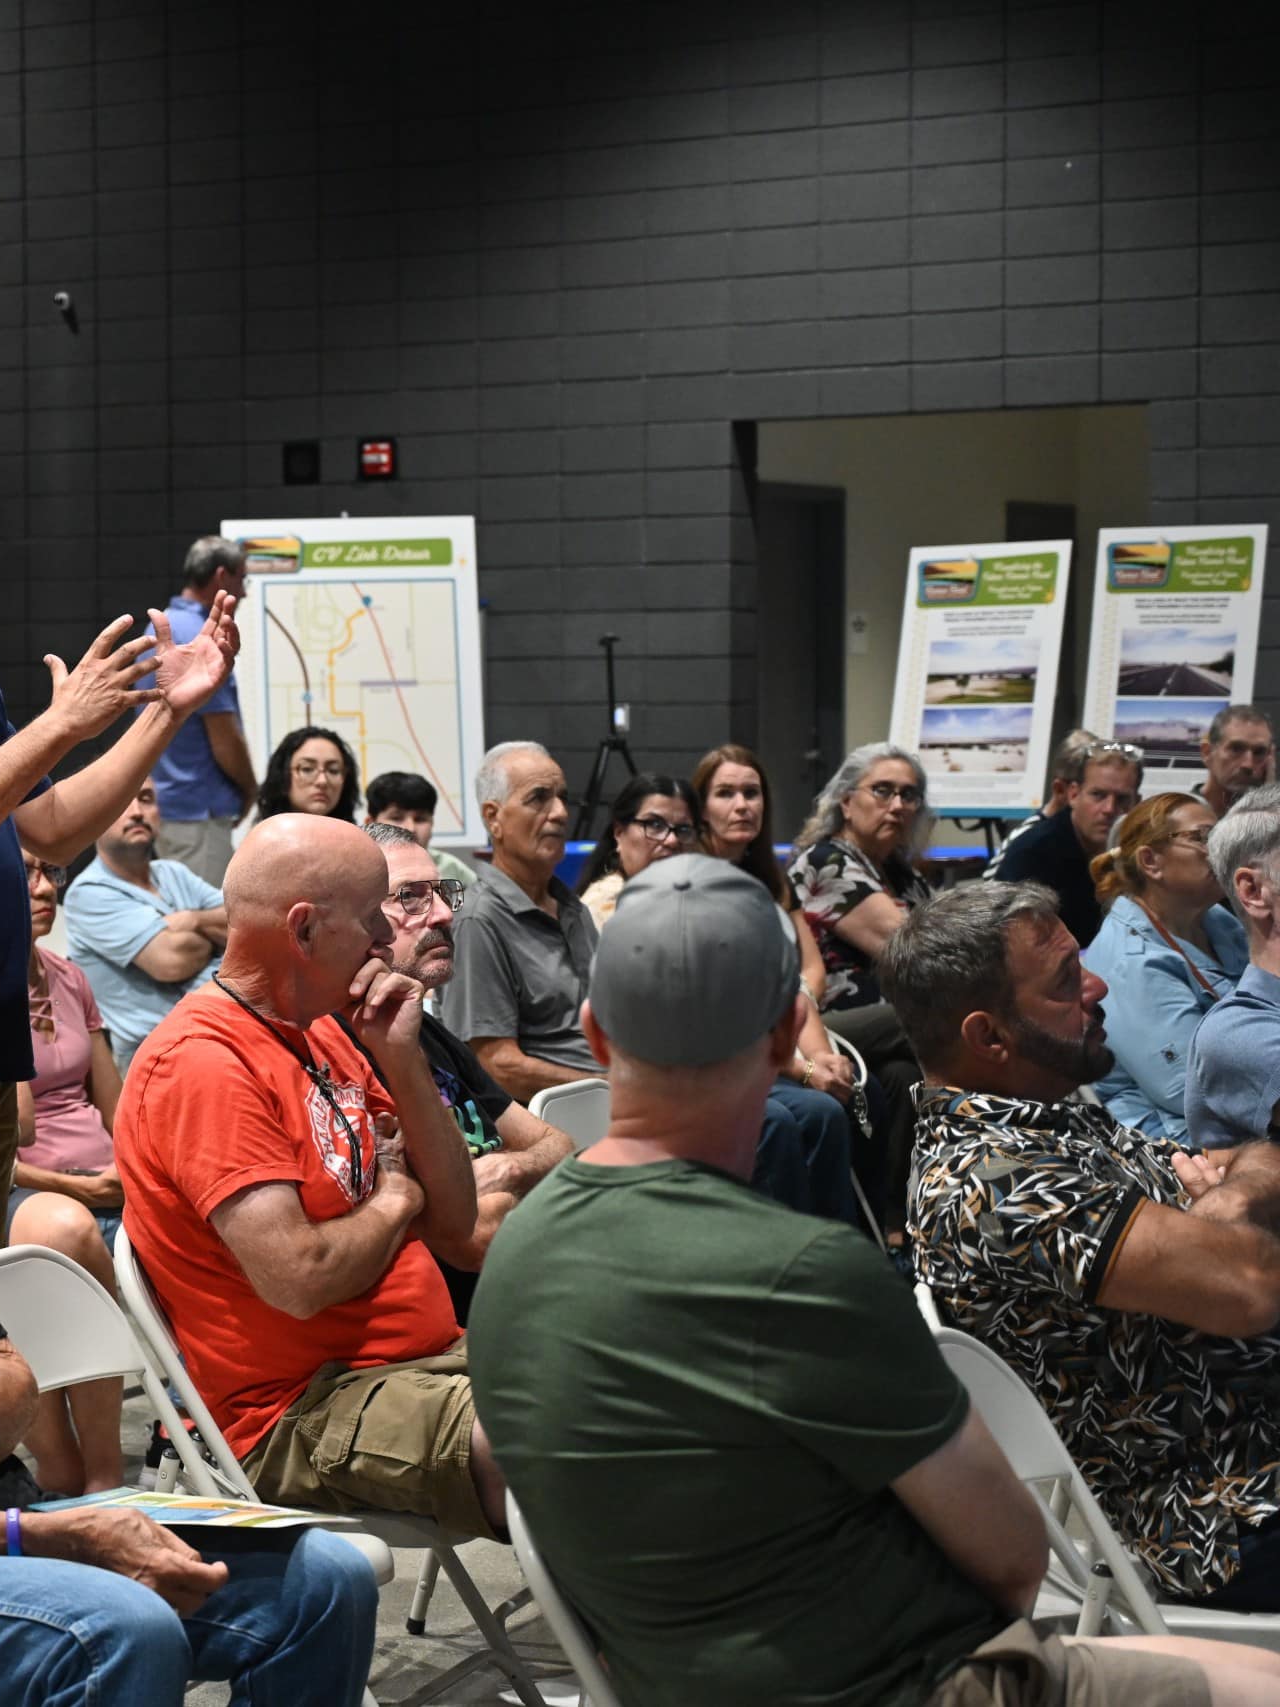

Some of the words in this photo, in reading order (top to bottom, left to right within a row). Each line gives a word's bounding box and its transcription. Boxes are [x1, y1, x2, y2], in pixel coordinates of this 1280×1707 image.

[312, 546, 344, 562] CV
[345, 546, 378, 562] Link
[382, 546, 431, 561] Detour
